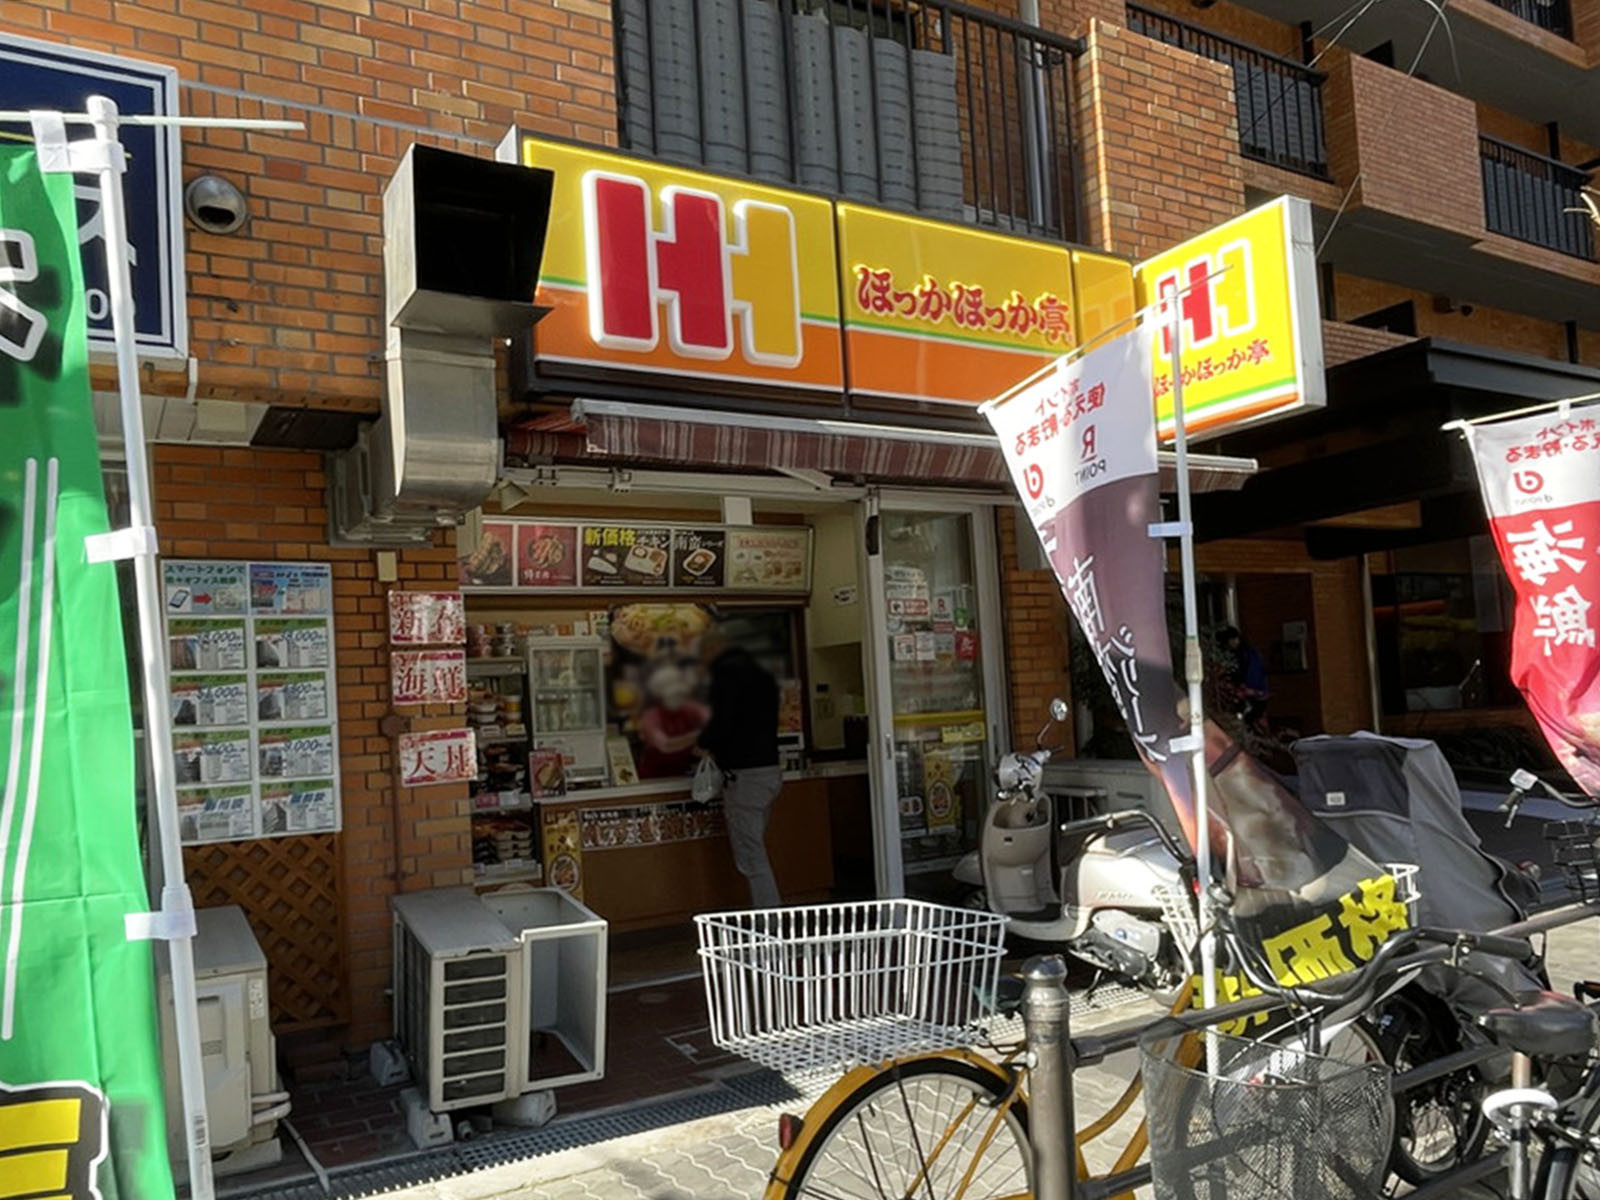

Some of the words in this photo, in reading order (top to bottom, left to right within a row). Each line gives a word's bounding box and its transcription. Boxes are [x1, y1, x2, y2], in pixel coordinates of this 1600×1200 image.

[854, 265, 1071, 342] ほっかほっか亭
[1153, 338, 1271, 398] ほかほっか亭
[584, 527, 637, 547] 新価格
